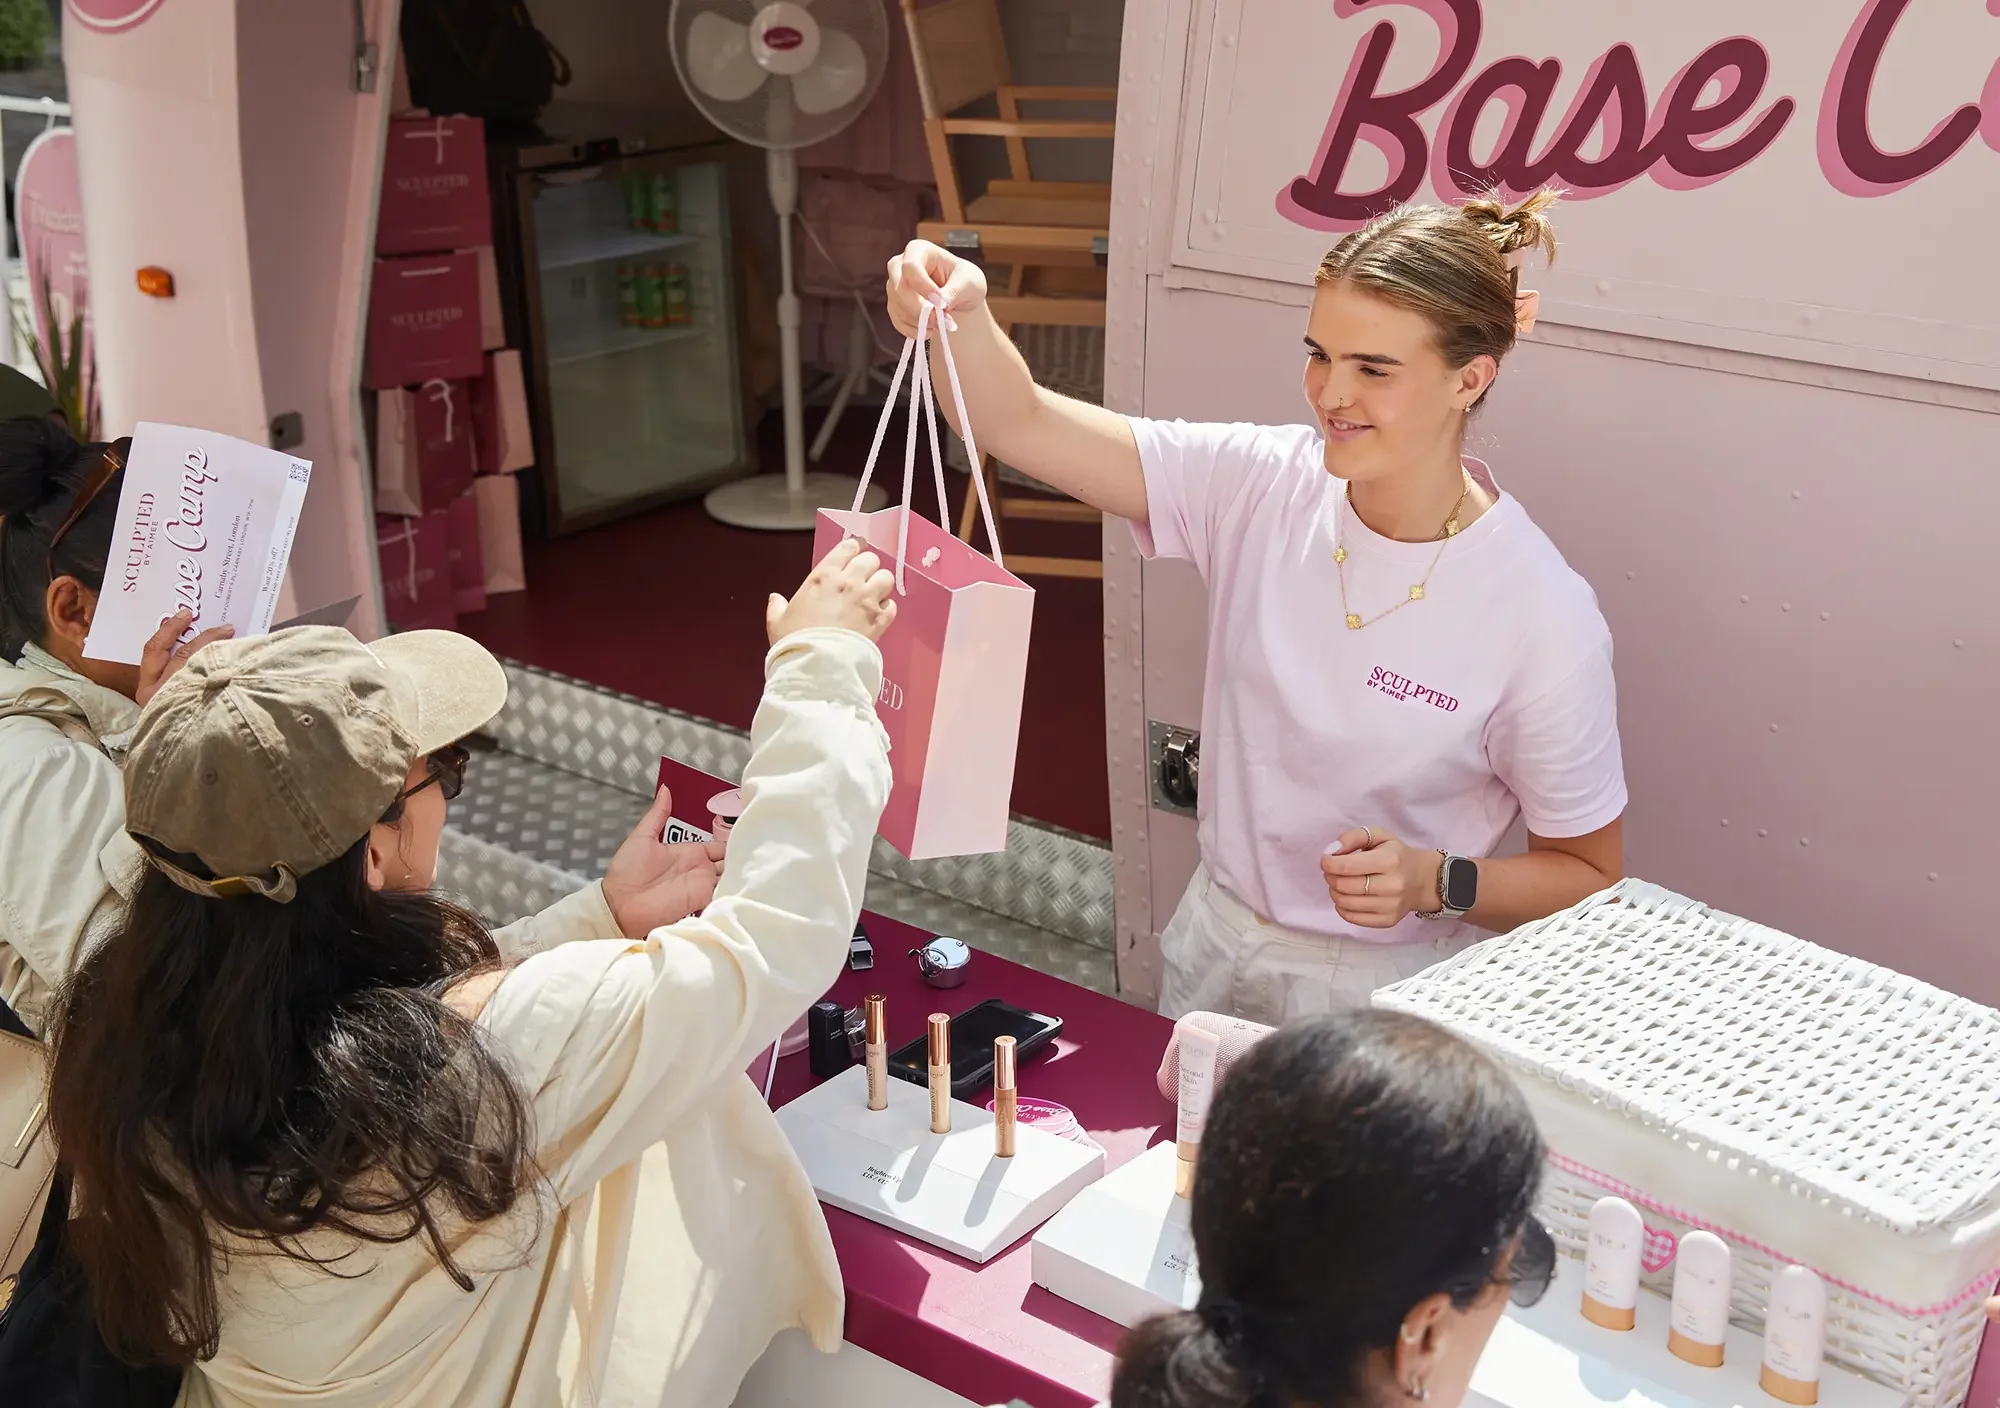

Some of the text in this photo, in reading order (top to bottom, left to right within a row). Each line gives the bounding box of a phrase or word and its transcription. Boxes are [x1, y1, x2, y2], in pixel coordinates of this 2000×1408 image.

[1276, 0, 2000, 233] Base C
[162, 446, 219, 552] Camp
[123, 493, 156, 592] SCULPTED
[143, 520, 160, 566] BY AIMEE
[214, 569, 229, 599] Carnaby
[228, 515, 241, 542] London
[262, 576, 271, 592] Want
[1367, 680, 1406, 701] BY AIMEE
[1371, 666, 1458, 712] SCULPTED
